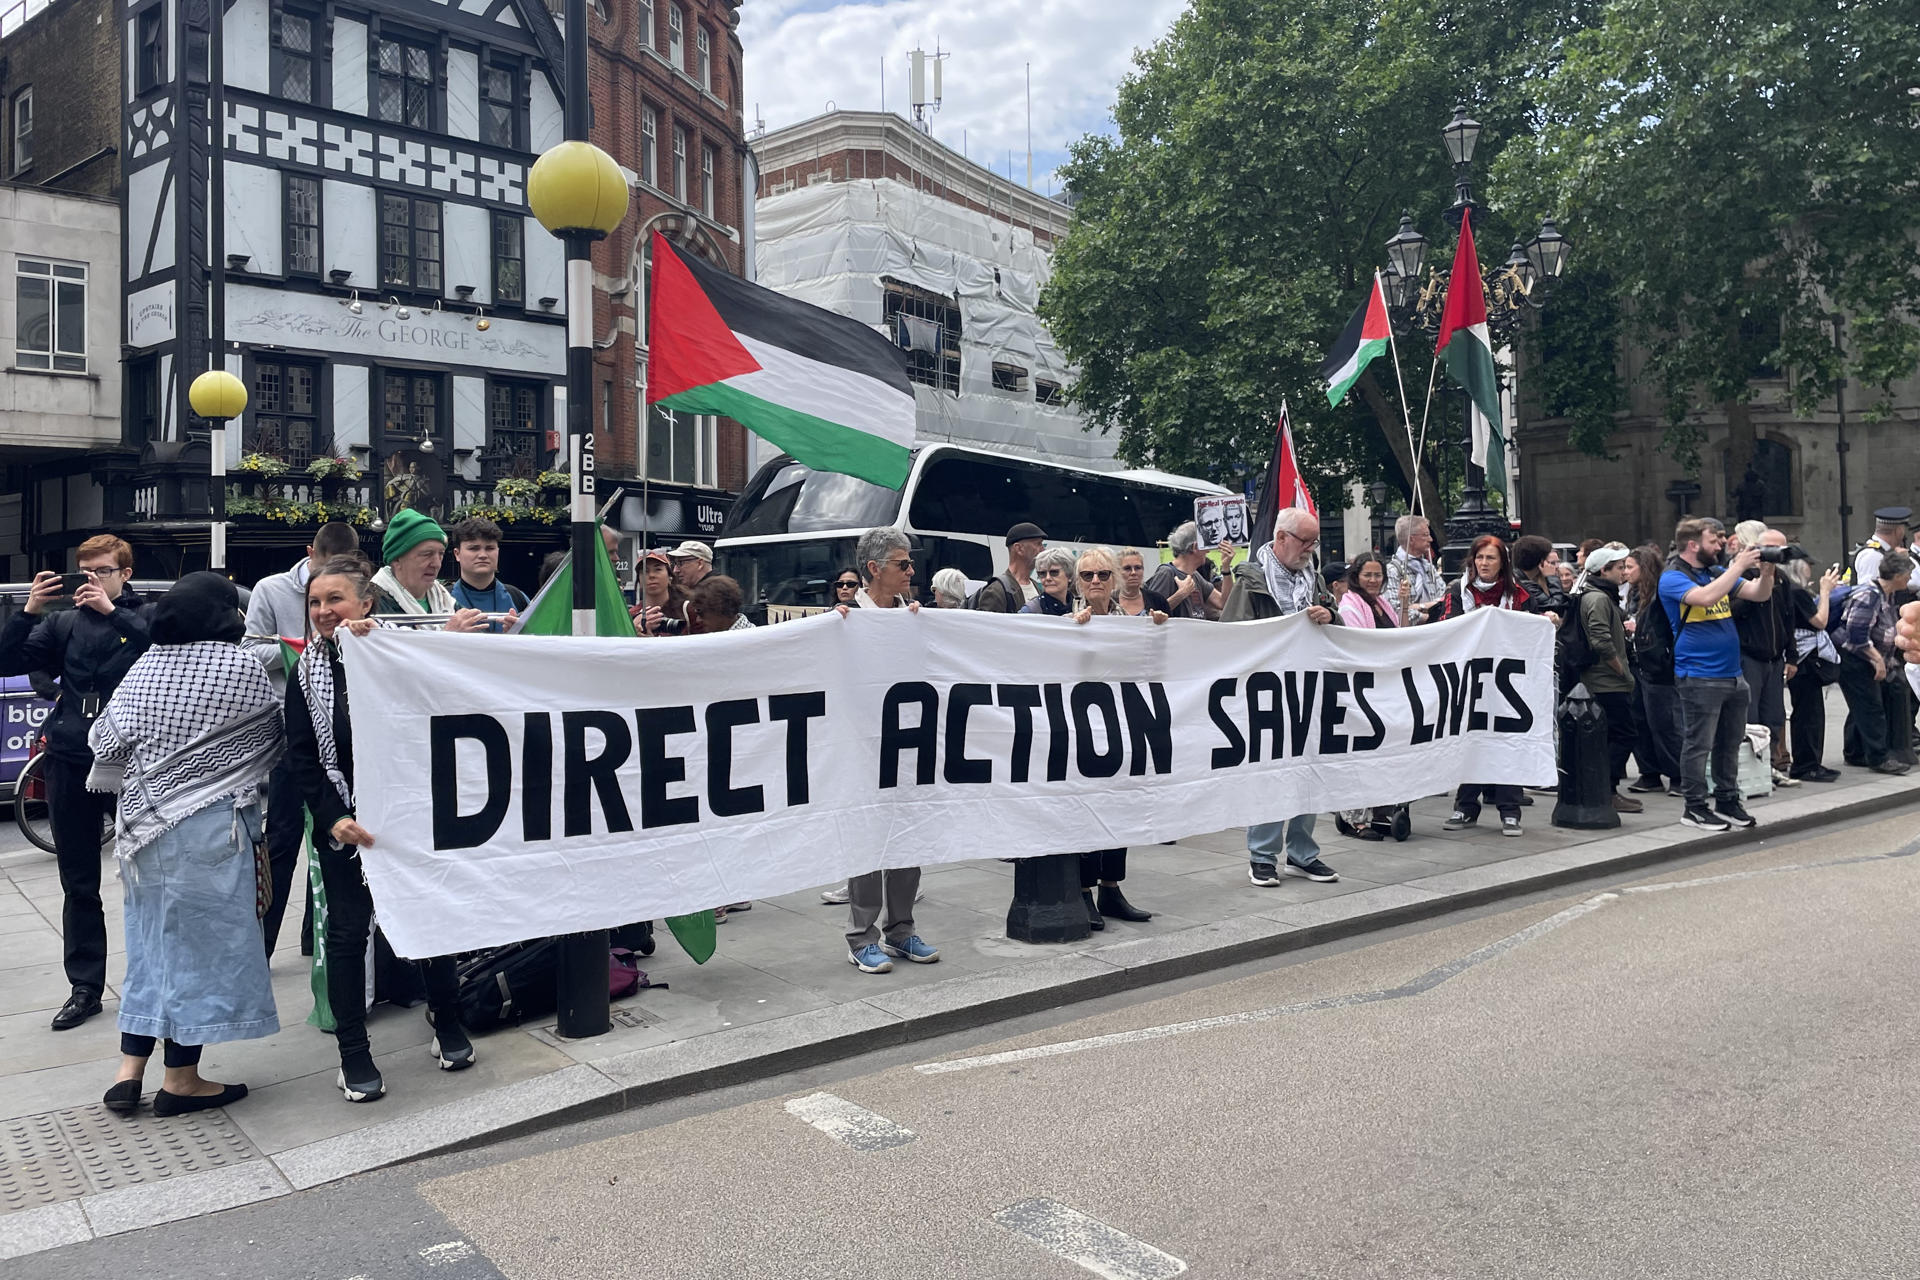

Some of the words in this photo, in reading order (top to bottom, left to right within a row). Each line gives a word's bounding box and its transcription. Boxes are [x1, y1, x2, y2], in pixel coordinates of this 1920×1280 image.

[335, 315, 372, 339] The
[378, 319, 470, 350] GEORGE
[697, 504, 724, 525] Ultra
[616, 561, 629, 571] 212
[7, 730, 35, 750] of
[430, 690, 826, 851] DIRECT
[879, 681, 1173, 789] ACTION
[1208, 670, 1386, 770] SAVES
[1401, 657, 1534, 746] LIVES
